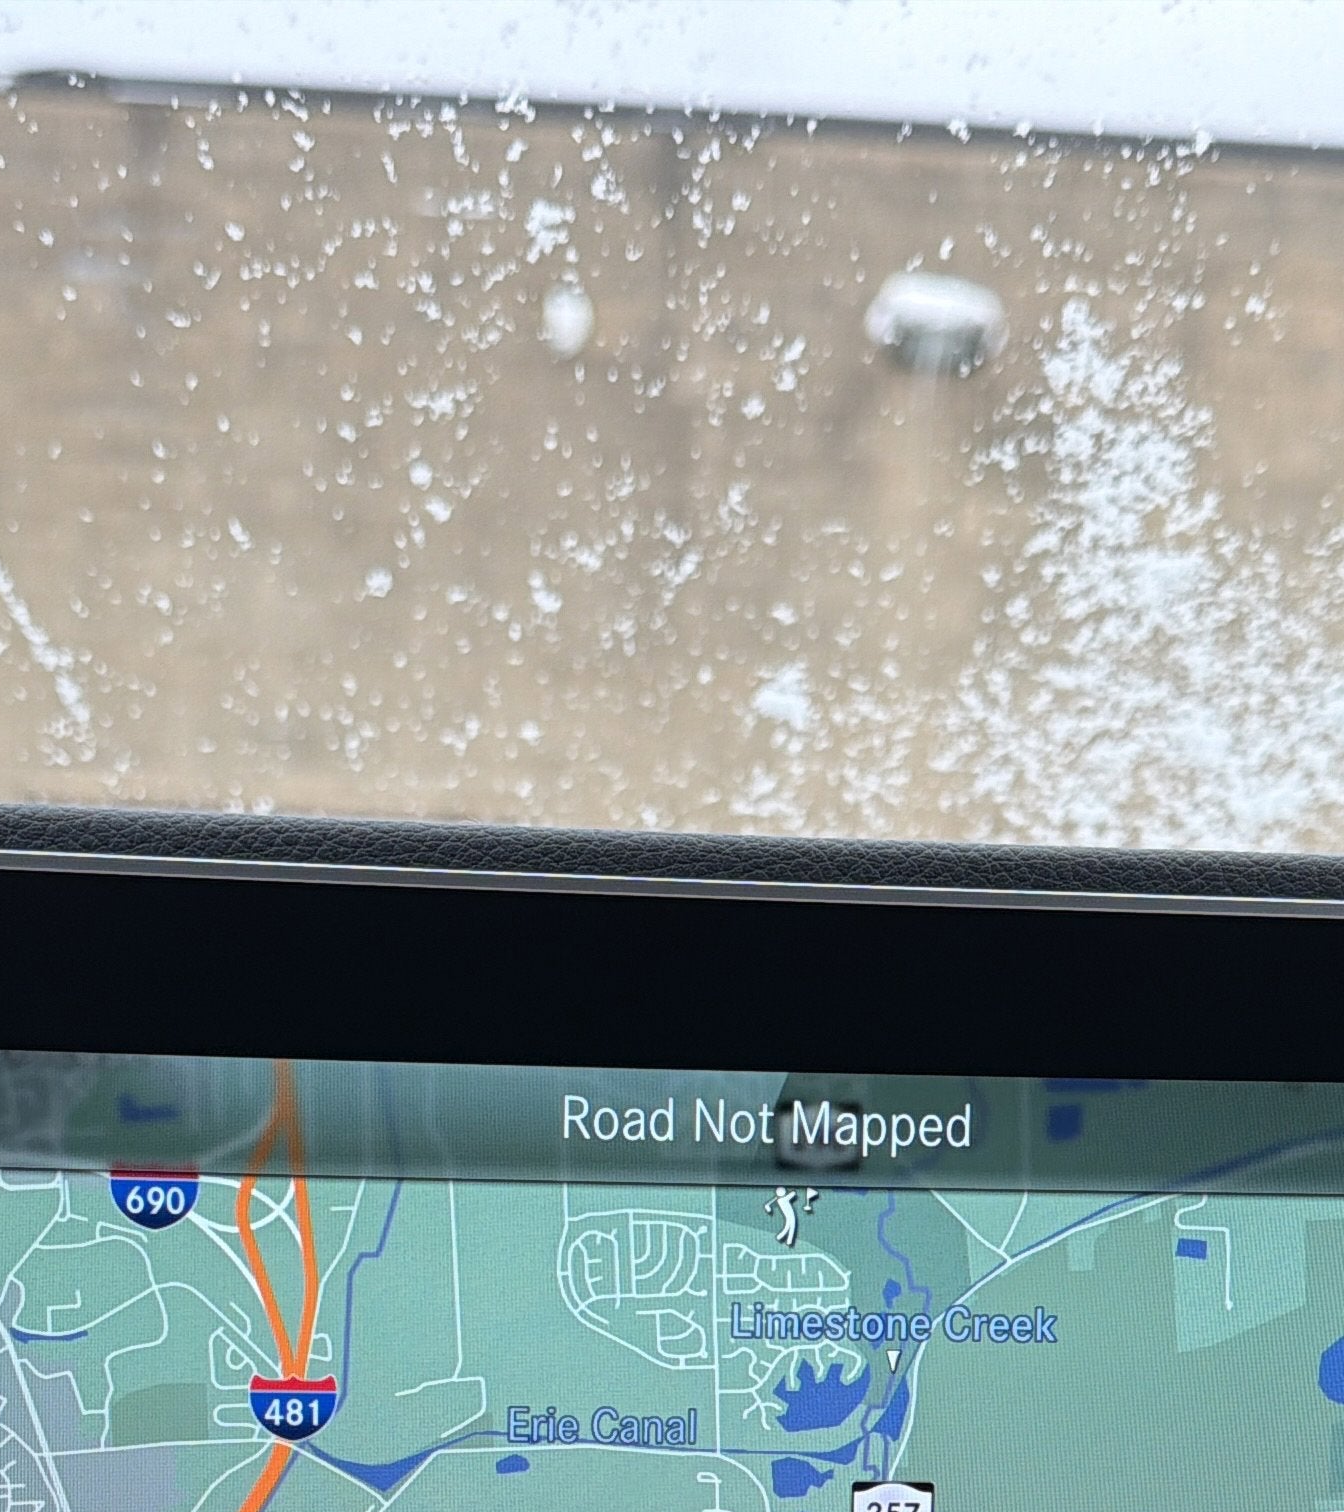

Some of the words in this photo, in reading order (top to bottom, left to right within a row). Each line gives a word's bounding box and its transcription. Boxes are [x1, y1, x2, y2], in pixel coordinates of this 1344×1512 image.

[562, 1094, 675, 1143] Road
[694, 1098, 775, 1145] Not
[791, 1100, 973, 1157] Mapped
[124, 1187, 186, 1217] 690
[730, 1302, 933, 1344] Limestone
[943, 1305, 1059, 1344] Creek
[263, 1399, 320, 1427] 481
[506, 1406, 580, 1442] Erie
[592, 1407, 697, 1446] Canal
